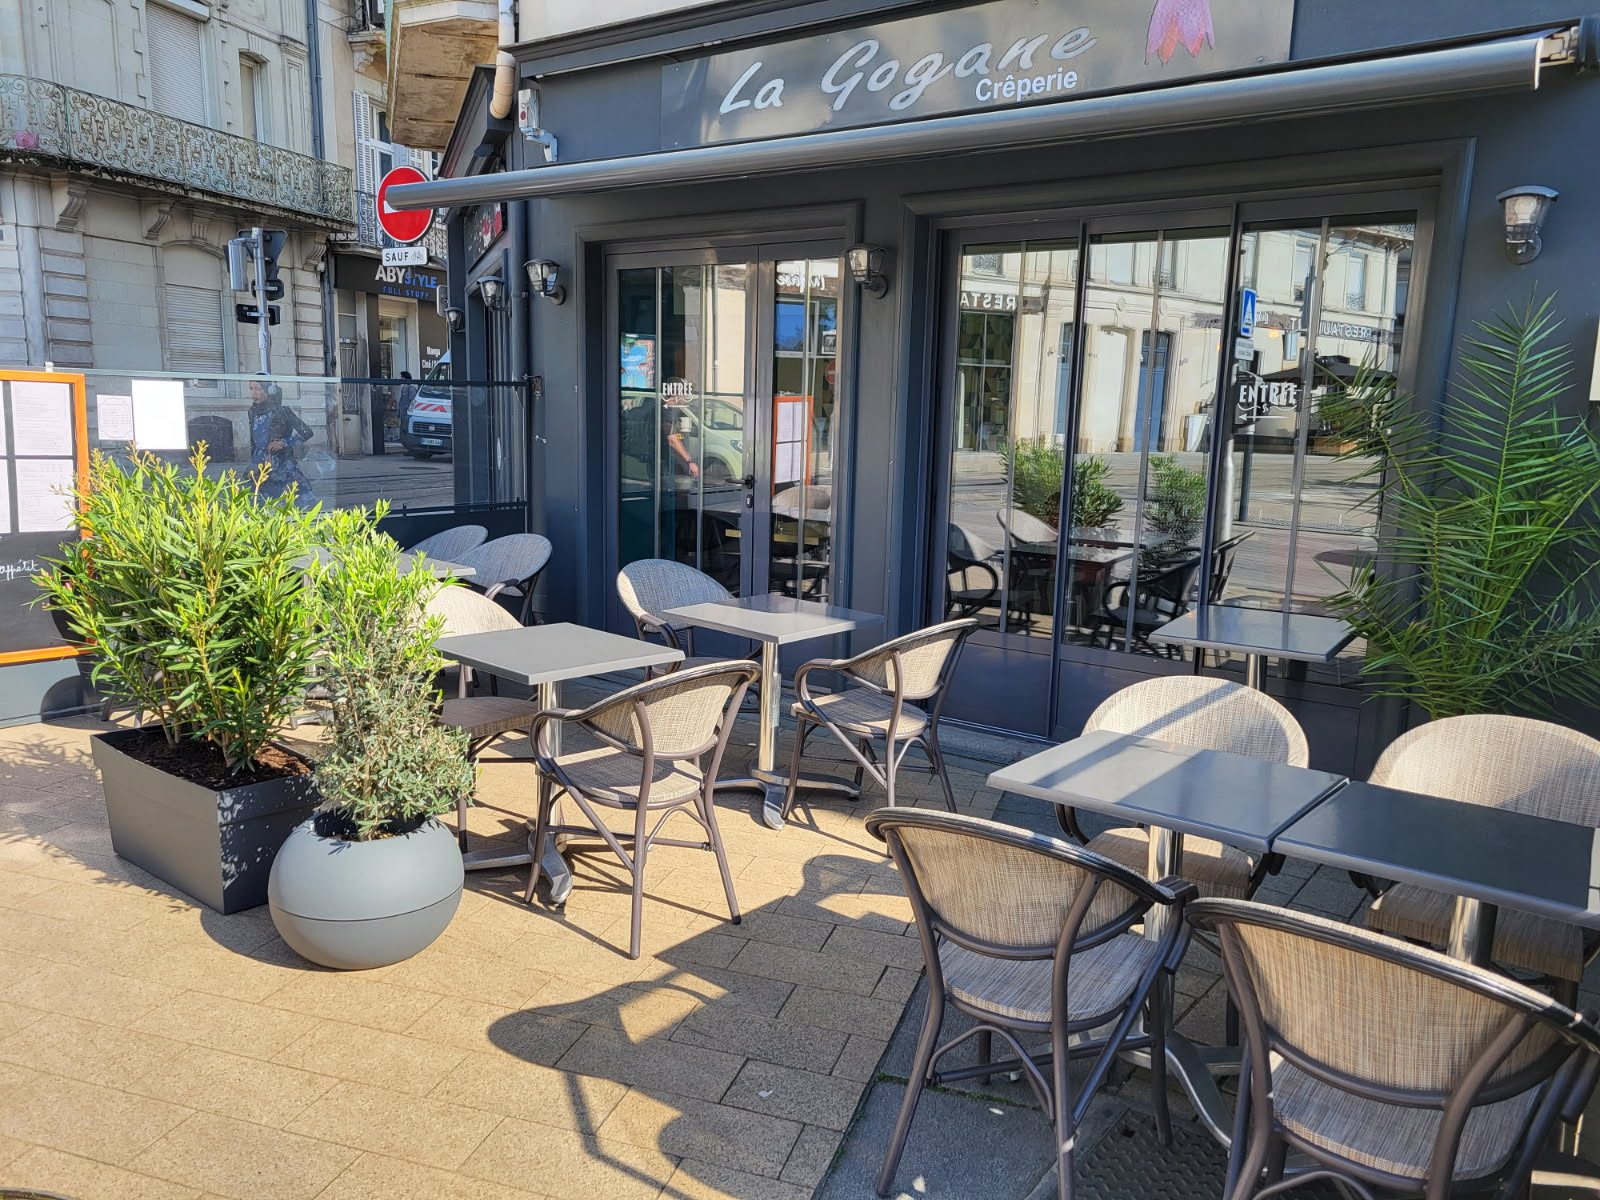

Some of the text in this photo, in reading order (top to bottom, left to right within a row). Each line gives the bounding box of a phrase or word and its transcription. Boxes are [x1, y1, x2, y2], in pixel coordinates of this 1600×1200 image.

[719, 27, 1097, 114] La Gogane
[974, 68, 1078, 102] Crêperie
[385, 253, 409, 262] SAUF
[383, 286, 401, 296] FULL
